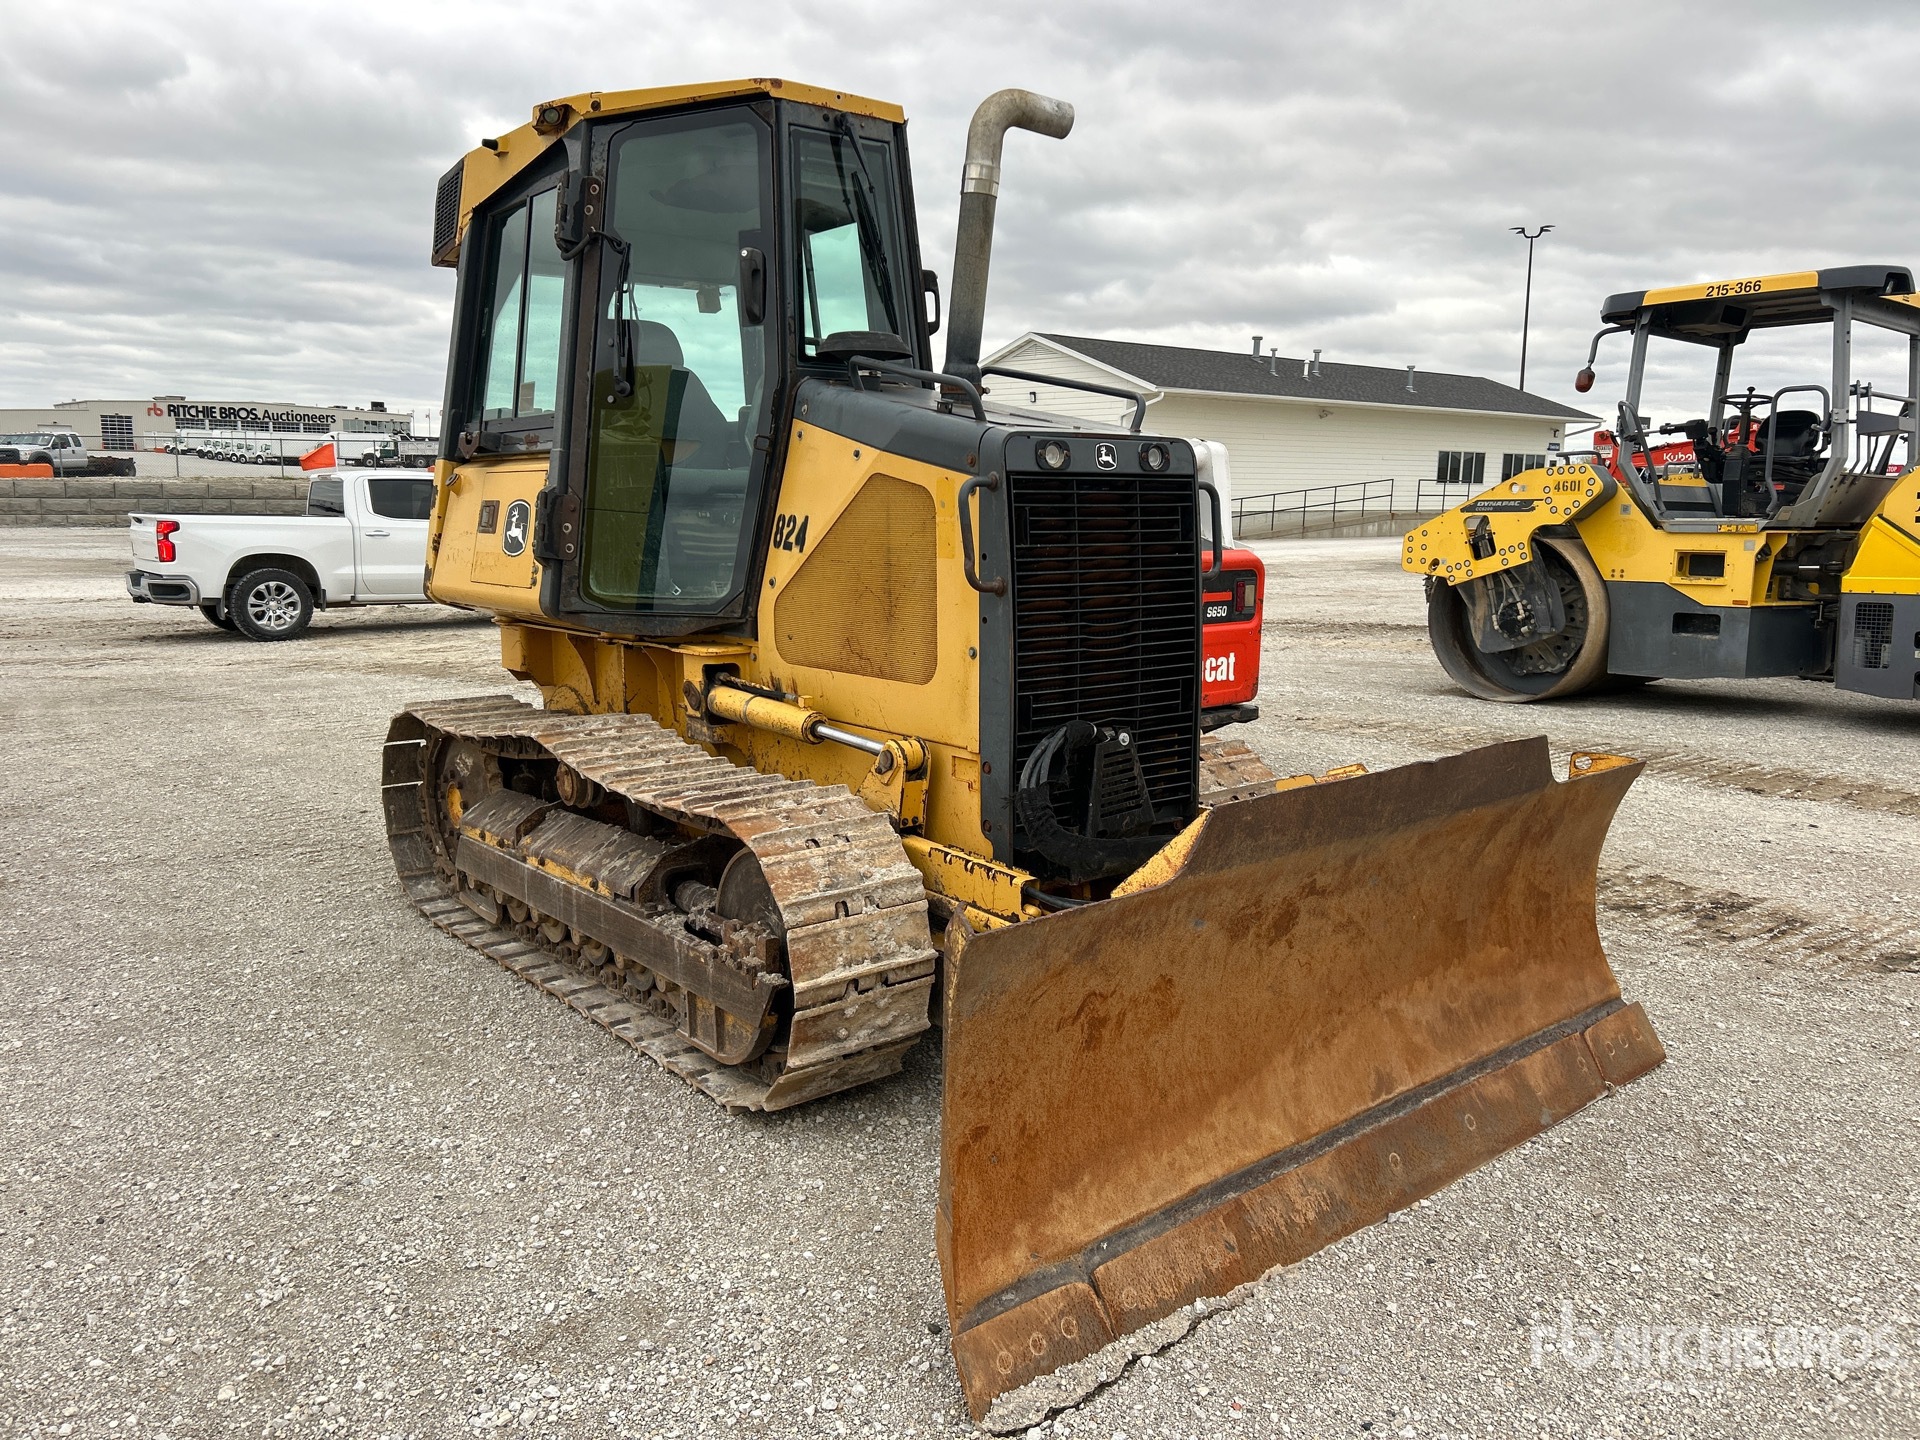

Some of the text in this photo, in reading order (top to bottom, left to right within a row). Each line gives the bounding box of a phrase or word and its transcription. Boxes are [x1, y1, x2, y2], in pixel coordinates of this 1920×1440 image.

[1705, 280, 1762, 297] 215-366
[167, 403, 217, 419] RITCHIE
[219, 406, 262, 421] BROS.
[262, 409, 337, 424] Auctioneers
[1553, 480, 1581, 493] 4601
[773, 513, 809, 554] 824
[1206, 606, 1228, 618] S650
[1202, 652, 1236, 683] cat
